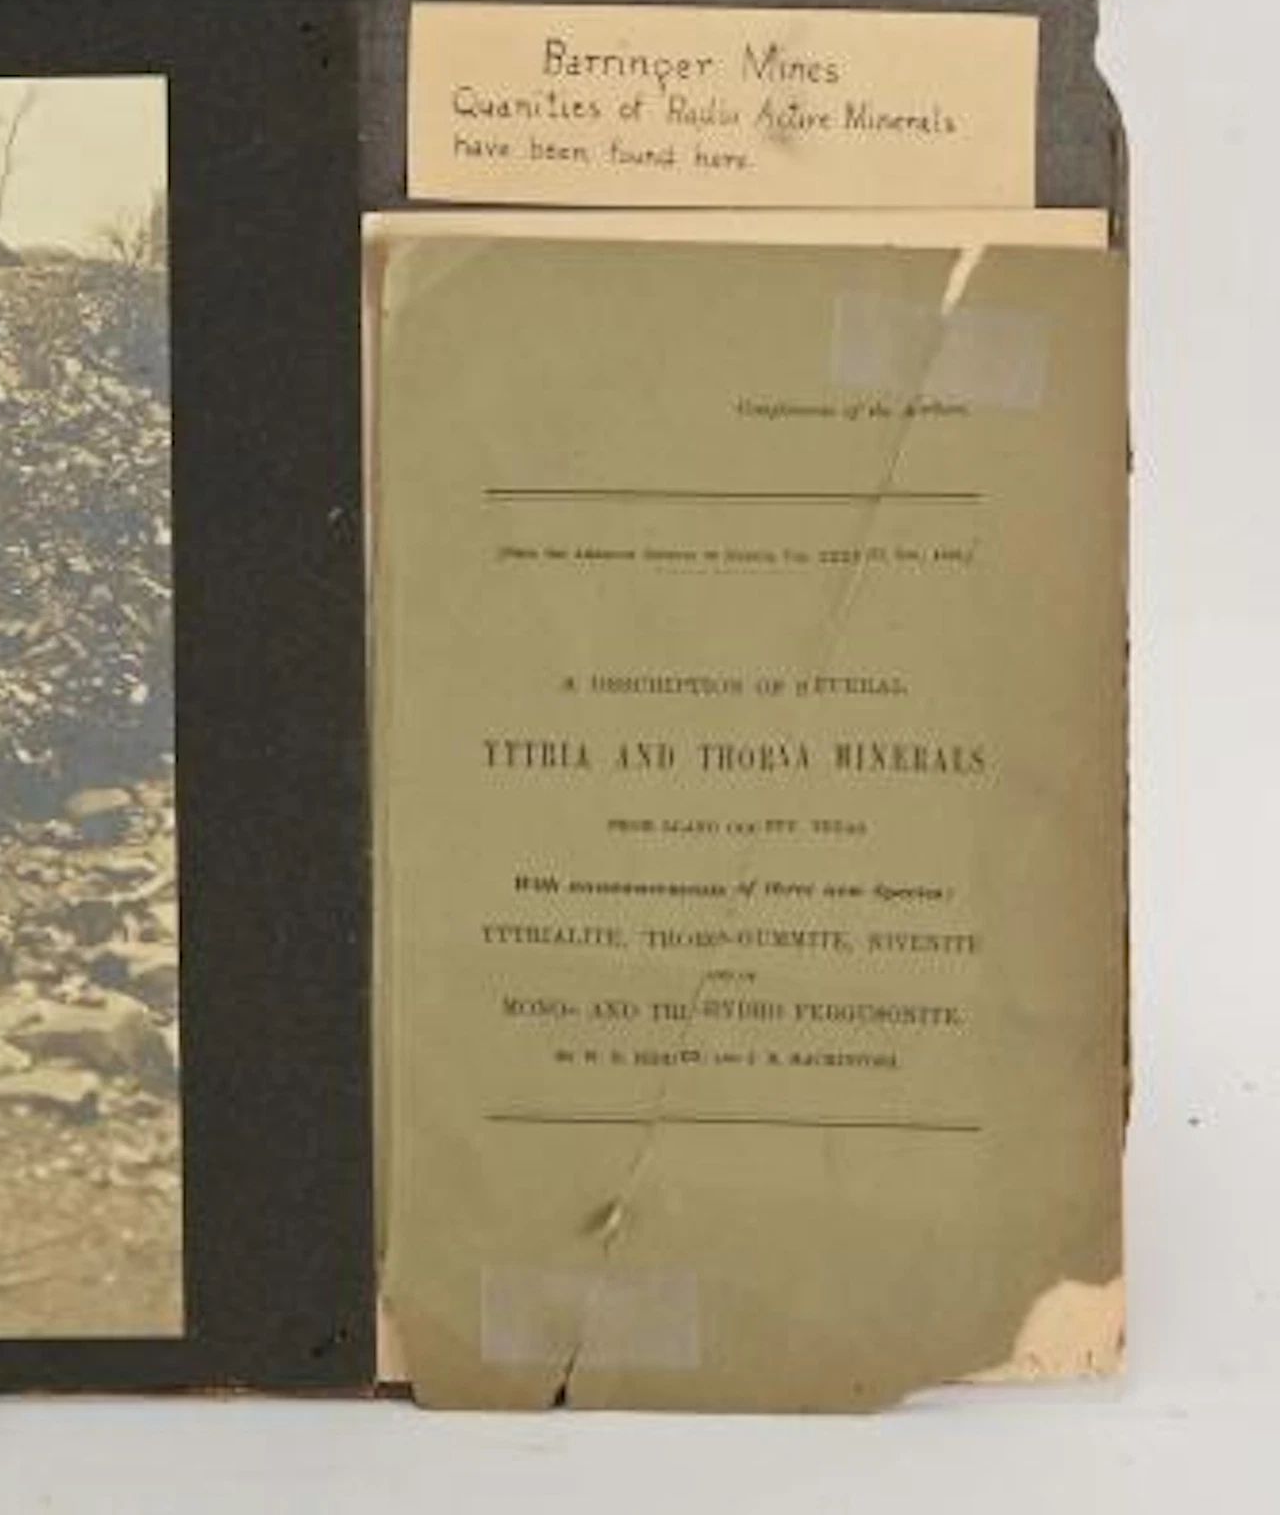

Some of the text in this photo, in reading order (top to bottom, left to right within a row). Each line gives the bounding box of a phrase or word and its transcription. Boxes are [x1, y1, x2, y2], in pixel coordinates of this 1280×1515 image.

[742, 41, 840, 85] Mines
[619, 94, 647, 121] of
[453, 135, 511, 160] have
[530, 136, 590, 163] been
[483, 739, 592, 771] YTTRIA
[614, 741, 676, 772] AND
[834, 741, 987, 776] MINERALS
